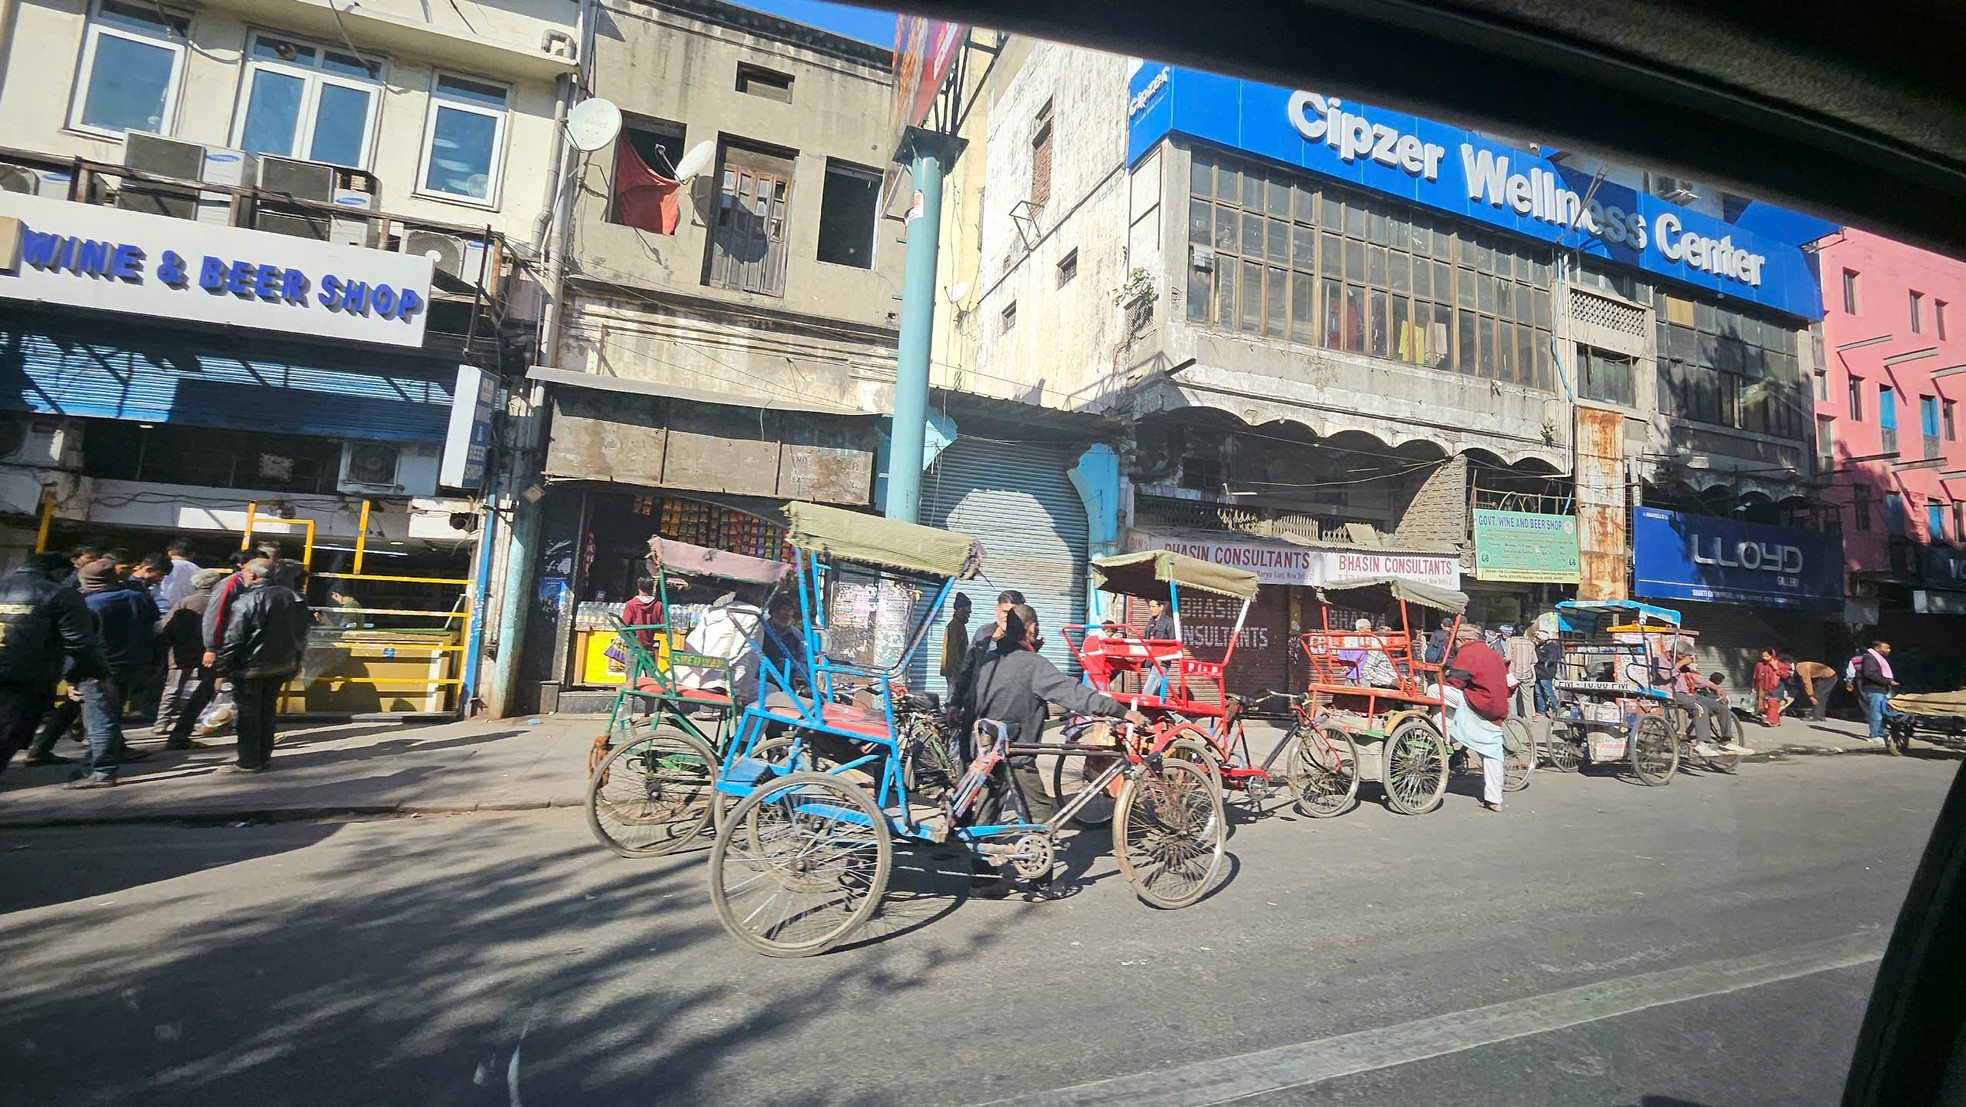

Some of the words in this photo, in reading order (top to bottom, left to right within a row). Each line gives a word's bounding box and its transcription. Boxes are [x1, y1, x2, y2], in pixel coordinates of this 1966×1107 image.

[1288, 89, 1445, 184] Cipzer
[1460, 142, 1648, 251] Wellness
[1654, 212, 1766, 290] Center
[23, 229, 147, 286] WINE
[157, 250, 189, 291] &
[198, 255, 310, 309] BEER
[318, 274, 424, 324] SHOP
[1499, 516, 1514, 528] WINE
[1517, 517, 1529, 529] AND
[1530, 518, 1546, 530] BEER
[1547, 519, 1562, 531] SHOP
[1214, 546, 1310, 570] CONSULTANTS
[1339, 555, 1380, 573] BHASIN
[1384, 558, 1452, 575] CONSULTANTS
[1691, 533, 1803, 574] LLOYD
